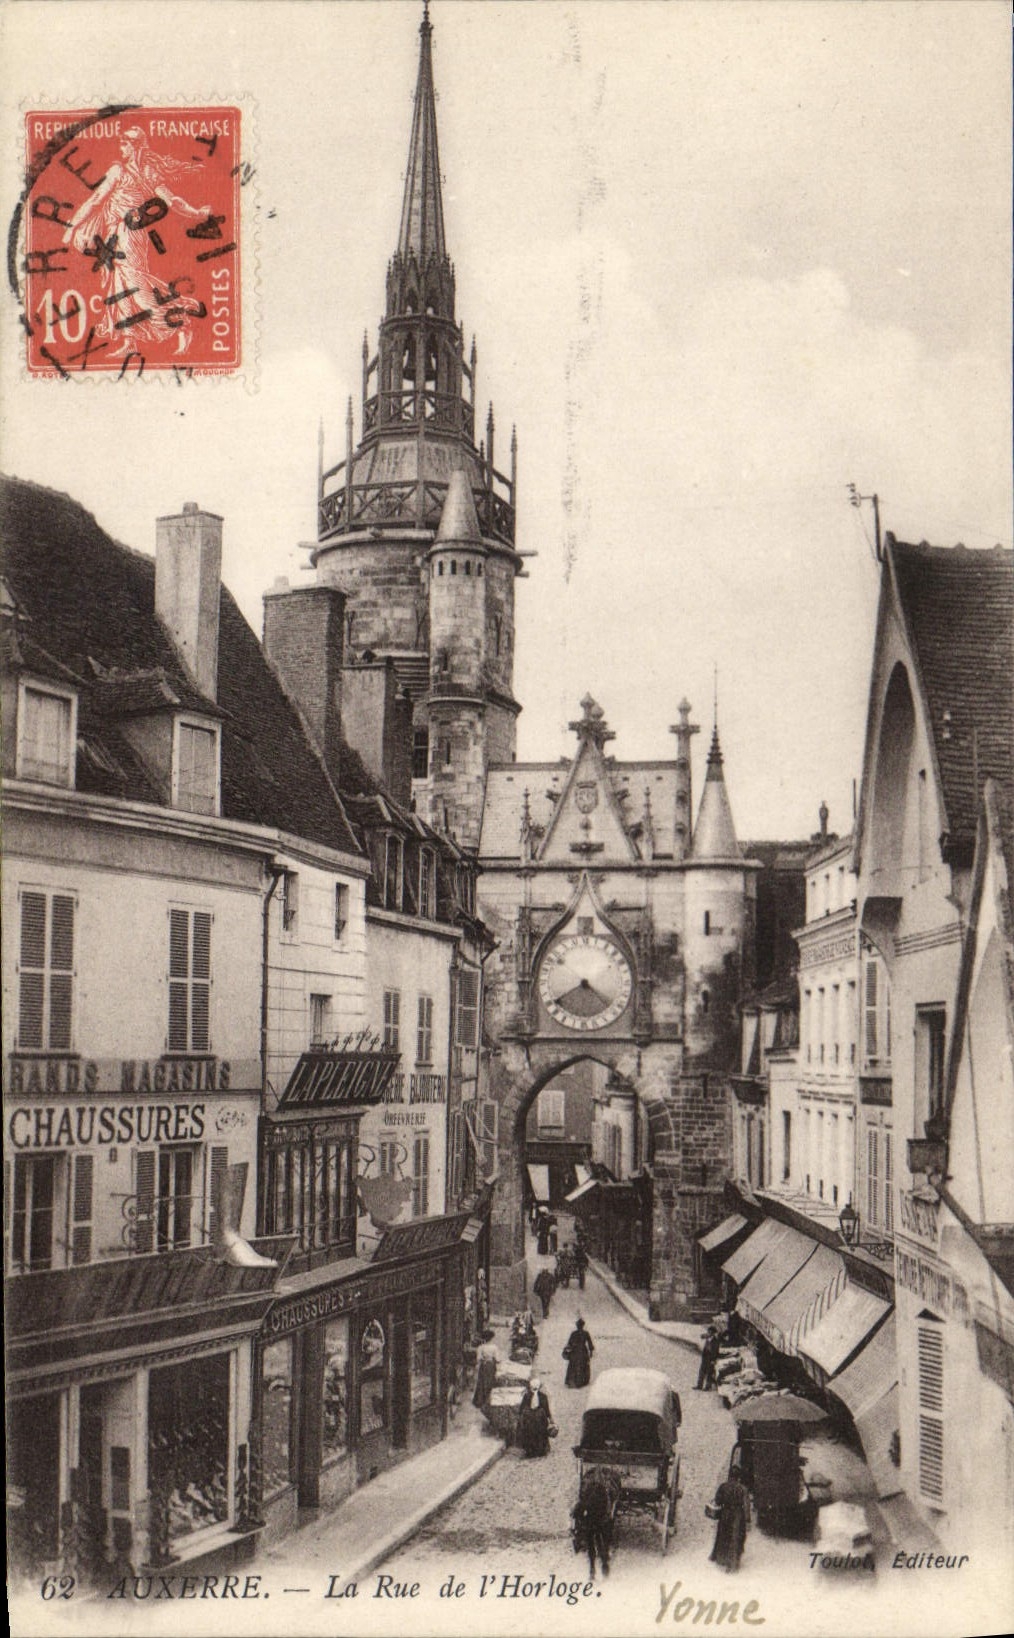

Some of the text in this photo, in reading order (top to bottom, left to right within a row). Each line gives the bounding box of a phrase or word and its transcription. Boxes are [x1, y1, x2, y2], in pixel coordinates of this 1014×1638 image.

[34, 120, 121, 141] REPULIQUE
[211, 267, 230, 352] POSTES
[121, 1059, 231, 1091] MAGASINS
[287, 1060, 397, 1101] LAPLEIGNE
[9, 1103, 206, 1148] CHAUSSURES
[654, 1580, 766, 1625] Yonne
